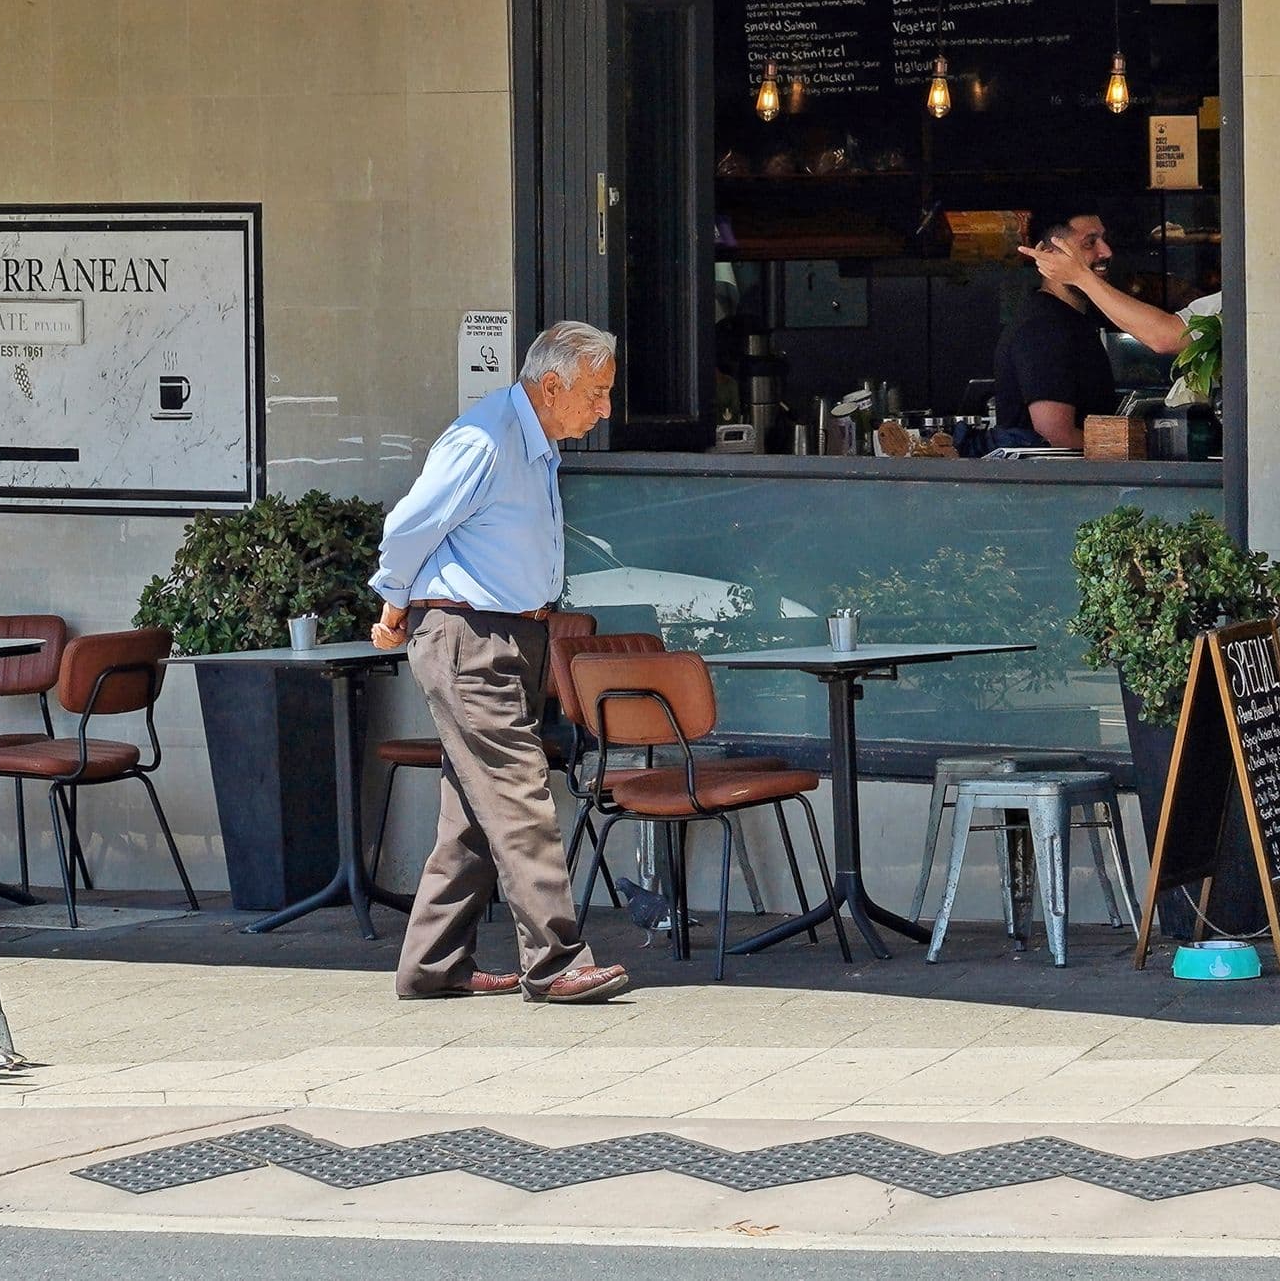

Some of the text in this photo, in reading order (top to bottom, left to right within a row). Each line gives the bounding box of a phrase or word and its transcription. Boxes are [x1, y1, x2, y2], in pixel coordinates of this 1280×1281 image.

[744, 20, 818, 33] Smoked Salmon
[892, 20, 956, 35] Vegetaran
[791, 44, 846, 62] Schnitzel
[894, 60, 934, 75] Hallou
[749, 73, 783, 84] Len
[813, 72, 855, 83] Chicken
[474, 315, 508, 325] SMOKING
[0, 345, 21, 358] EST.
[1227, 632, 1280, 698] SPECIAL
